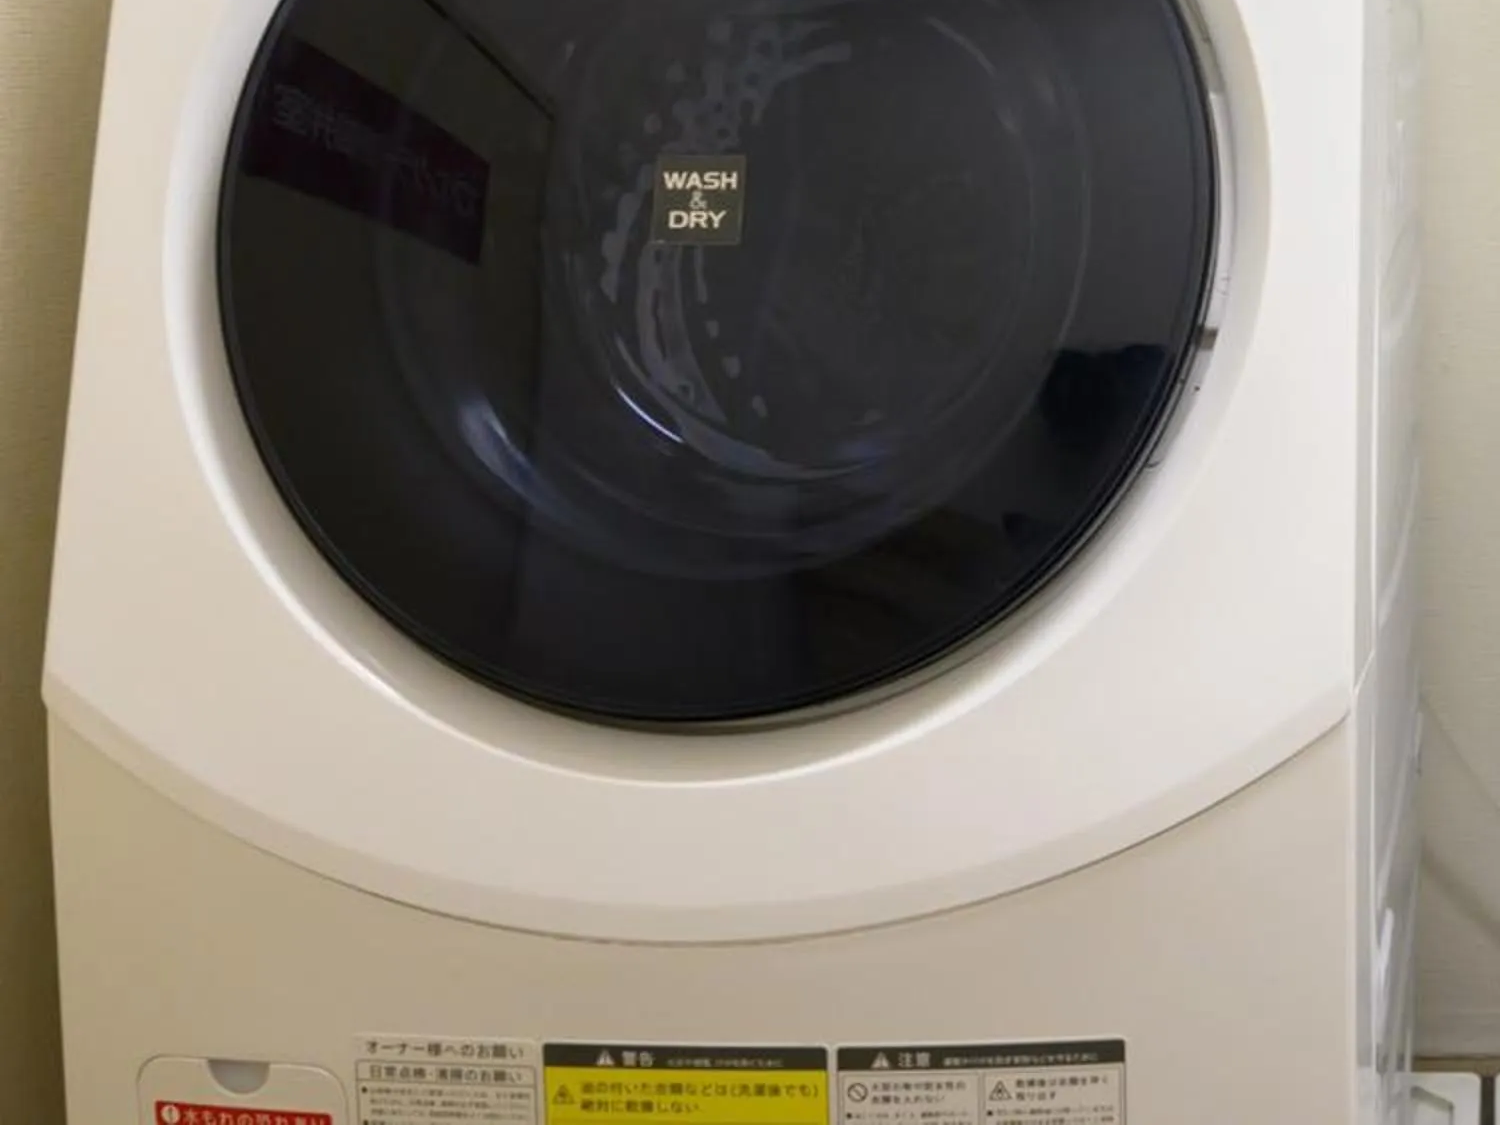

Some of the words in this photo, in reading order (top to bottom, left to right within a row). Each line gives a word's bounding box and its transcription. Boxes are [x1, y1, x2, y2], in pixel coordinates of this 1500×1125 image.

[663, 171, 738, 190] WASH
[689, 191, 707, 209] &
[668, 210, 727, 229] DRY
[366, 1040, 524, 1059] オーナー様へのお願い
[898, 1052, 931, 1068] 注意
